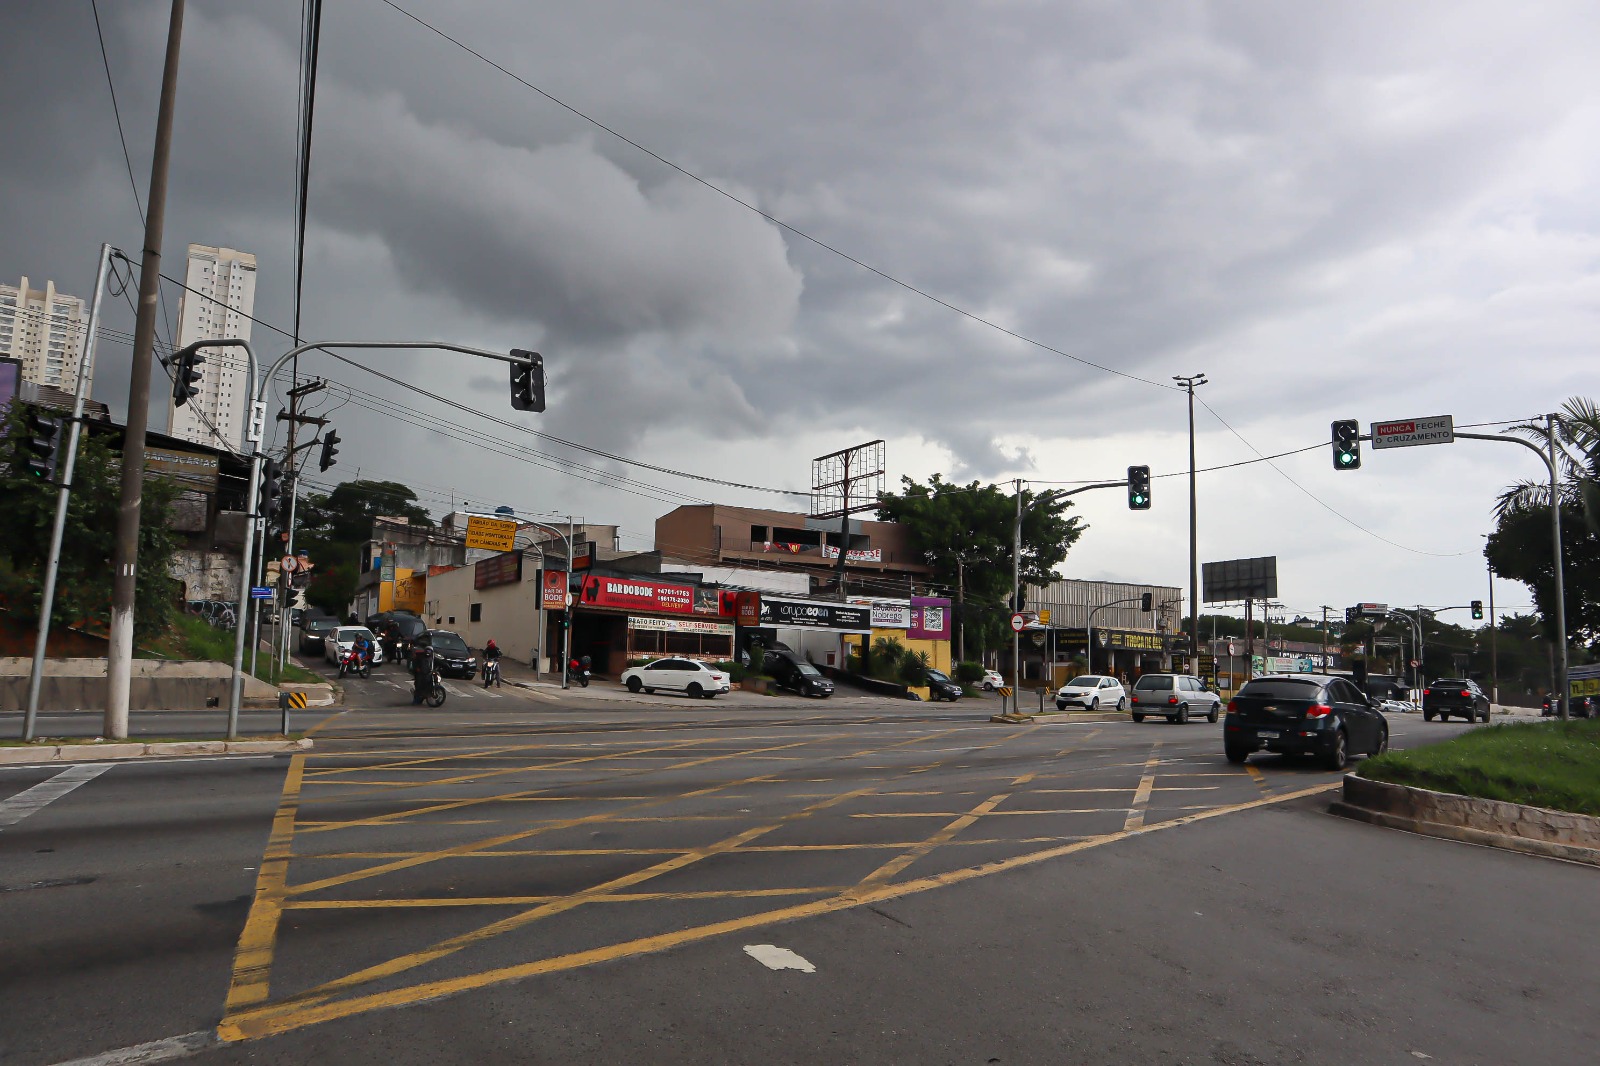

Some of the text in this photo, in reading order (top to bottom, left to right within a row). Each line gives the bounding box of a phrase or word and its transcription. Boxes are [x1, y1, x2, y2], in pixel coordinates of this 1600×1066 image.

[1380, 421, 1446, 434] NUNCA FECHE
[1387, 431, 1449, 442] CRUZAMENTO
[606, 582, 653, 597] BAR DO BODE
